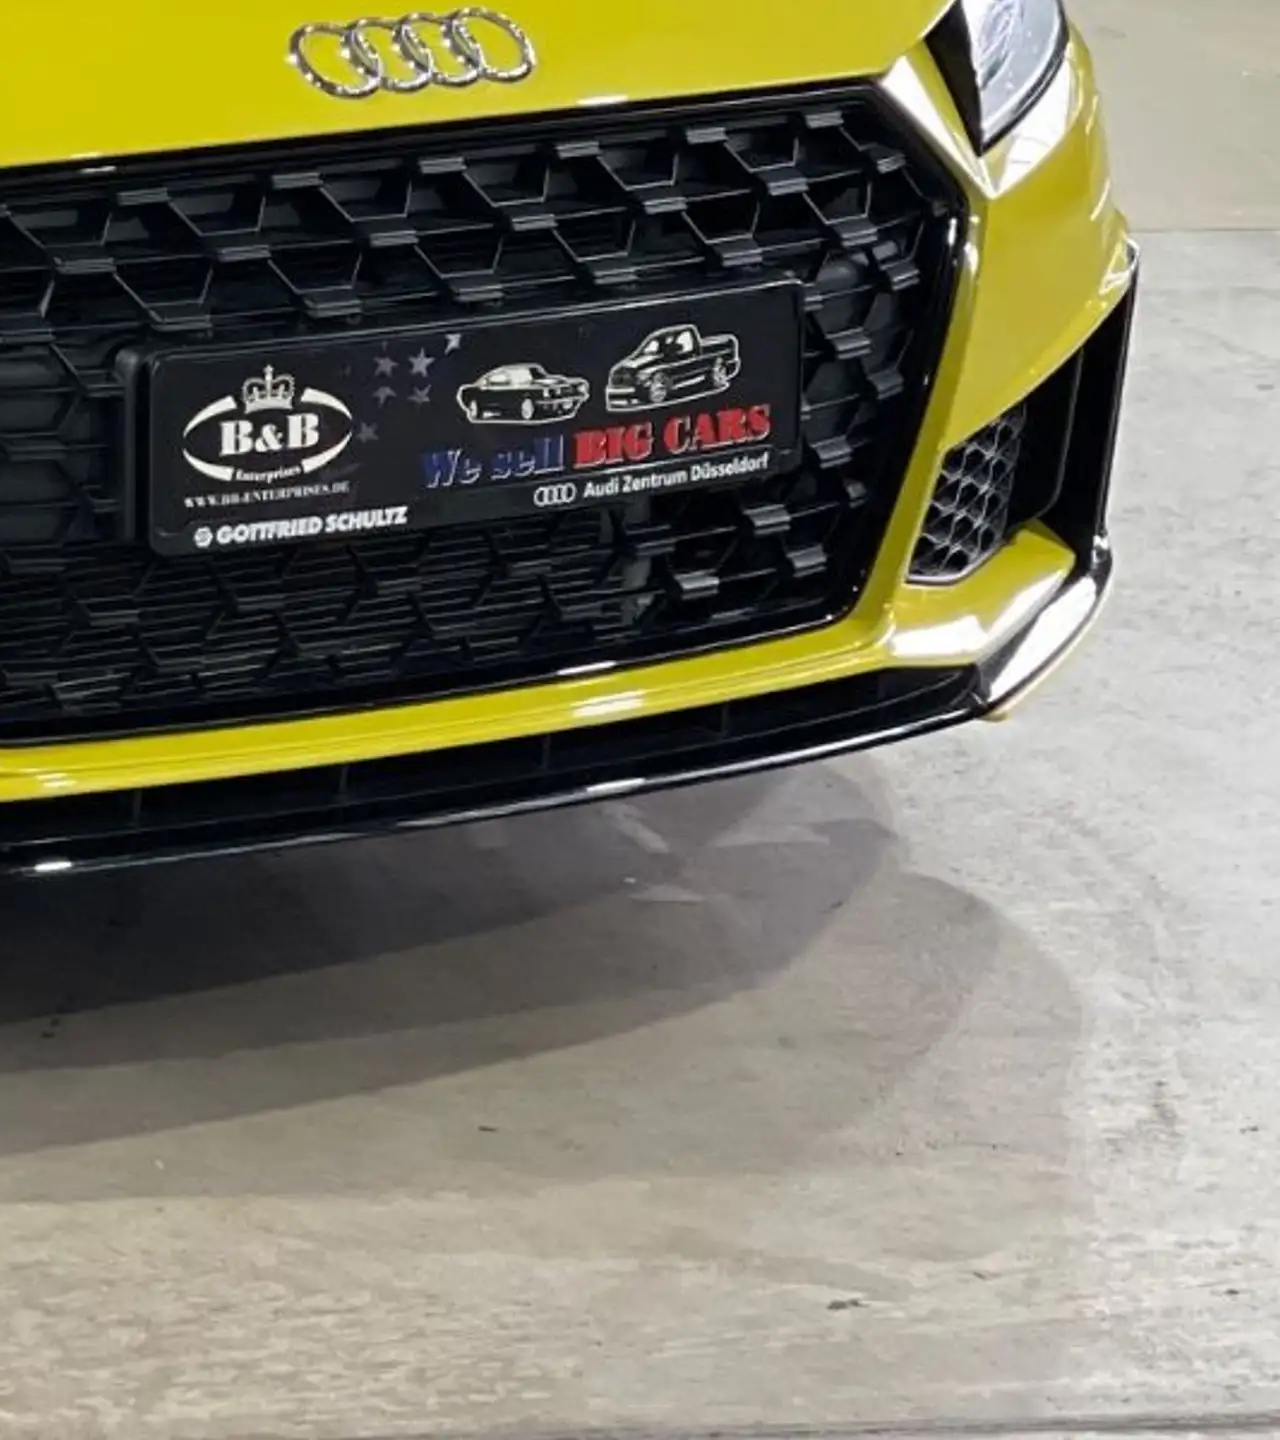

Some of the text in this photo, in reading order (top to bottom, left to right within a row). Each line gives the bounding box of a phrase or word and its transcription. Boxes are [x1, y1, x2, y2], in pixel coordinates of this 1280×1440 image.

[219, 413, 320, 457] B&B
[573, 421, 654, 470] BIG
[664, 403, 772, 454] CARS
[235, 466, 302, 484] Enterprises
[583, 451, 771, 499] Audi Zentrum Düsseldorf
[216, 506, 408, 545] GOTTFRIED SCHULTZ
